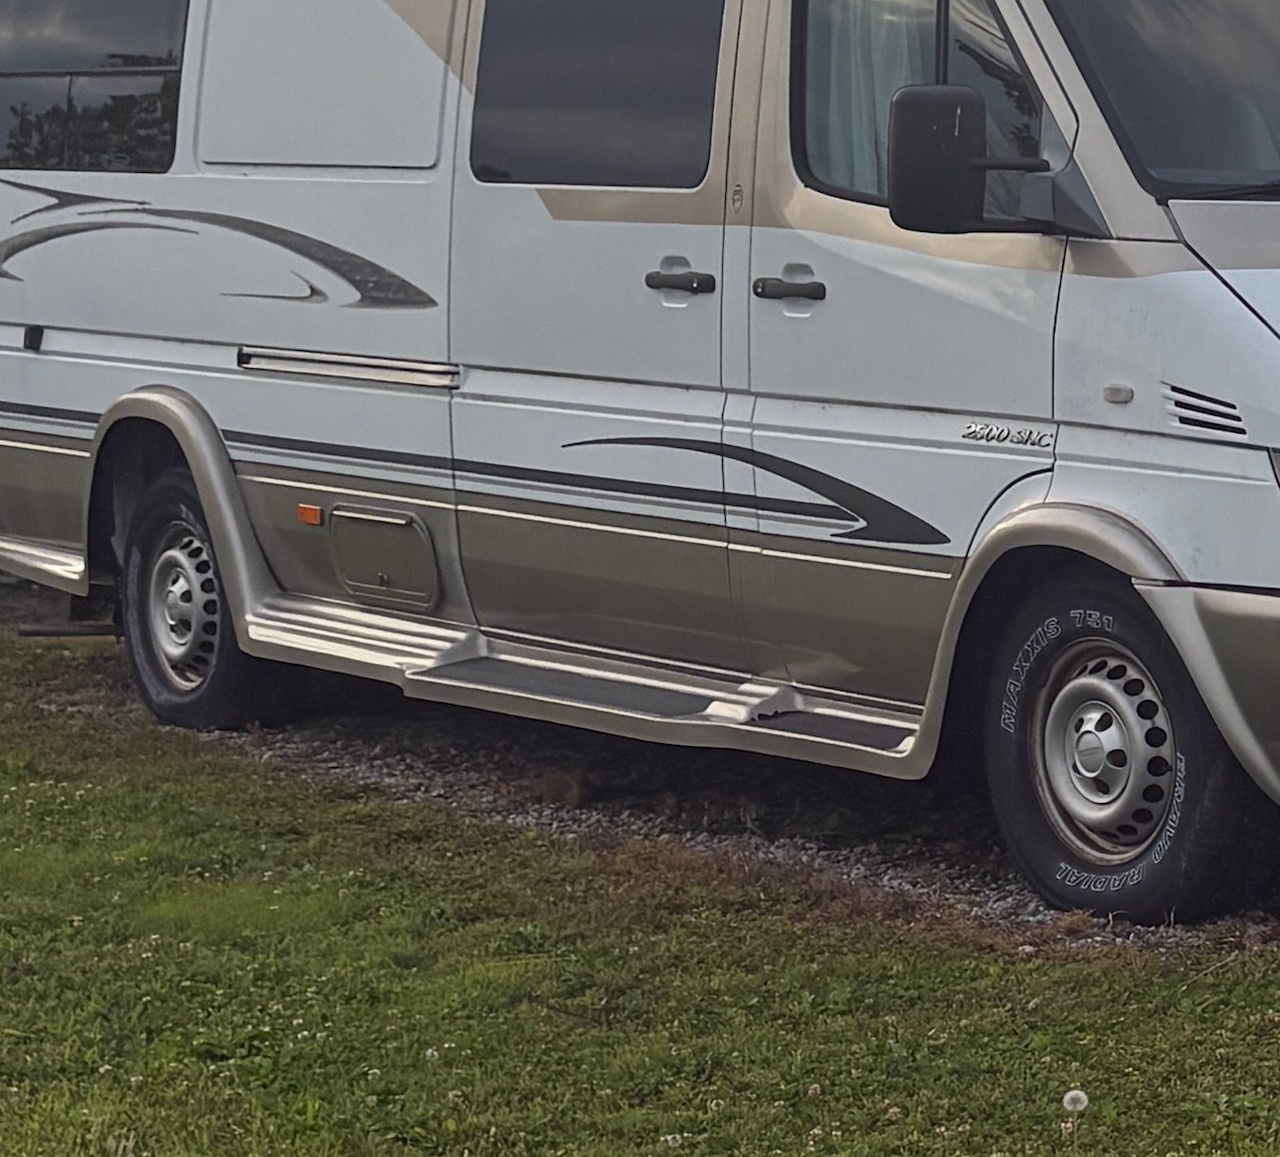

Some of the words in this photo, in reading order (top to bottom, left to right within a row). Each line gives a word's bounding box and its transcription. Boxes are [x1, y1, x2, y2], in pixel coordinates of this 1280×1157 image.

[962, 422, 1011, 443] 2500
[1000, 617, 1062, 733] MAXXIS
[1070, 609, 1115, 632] 751
[1056, 861, 1145, 892] RADIAL
